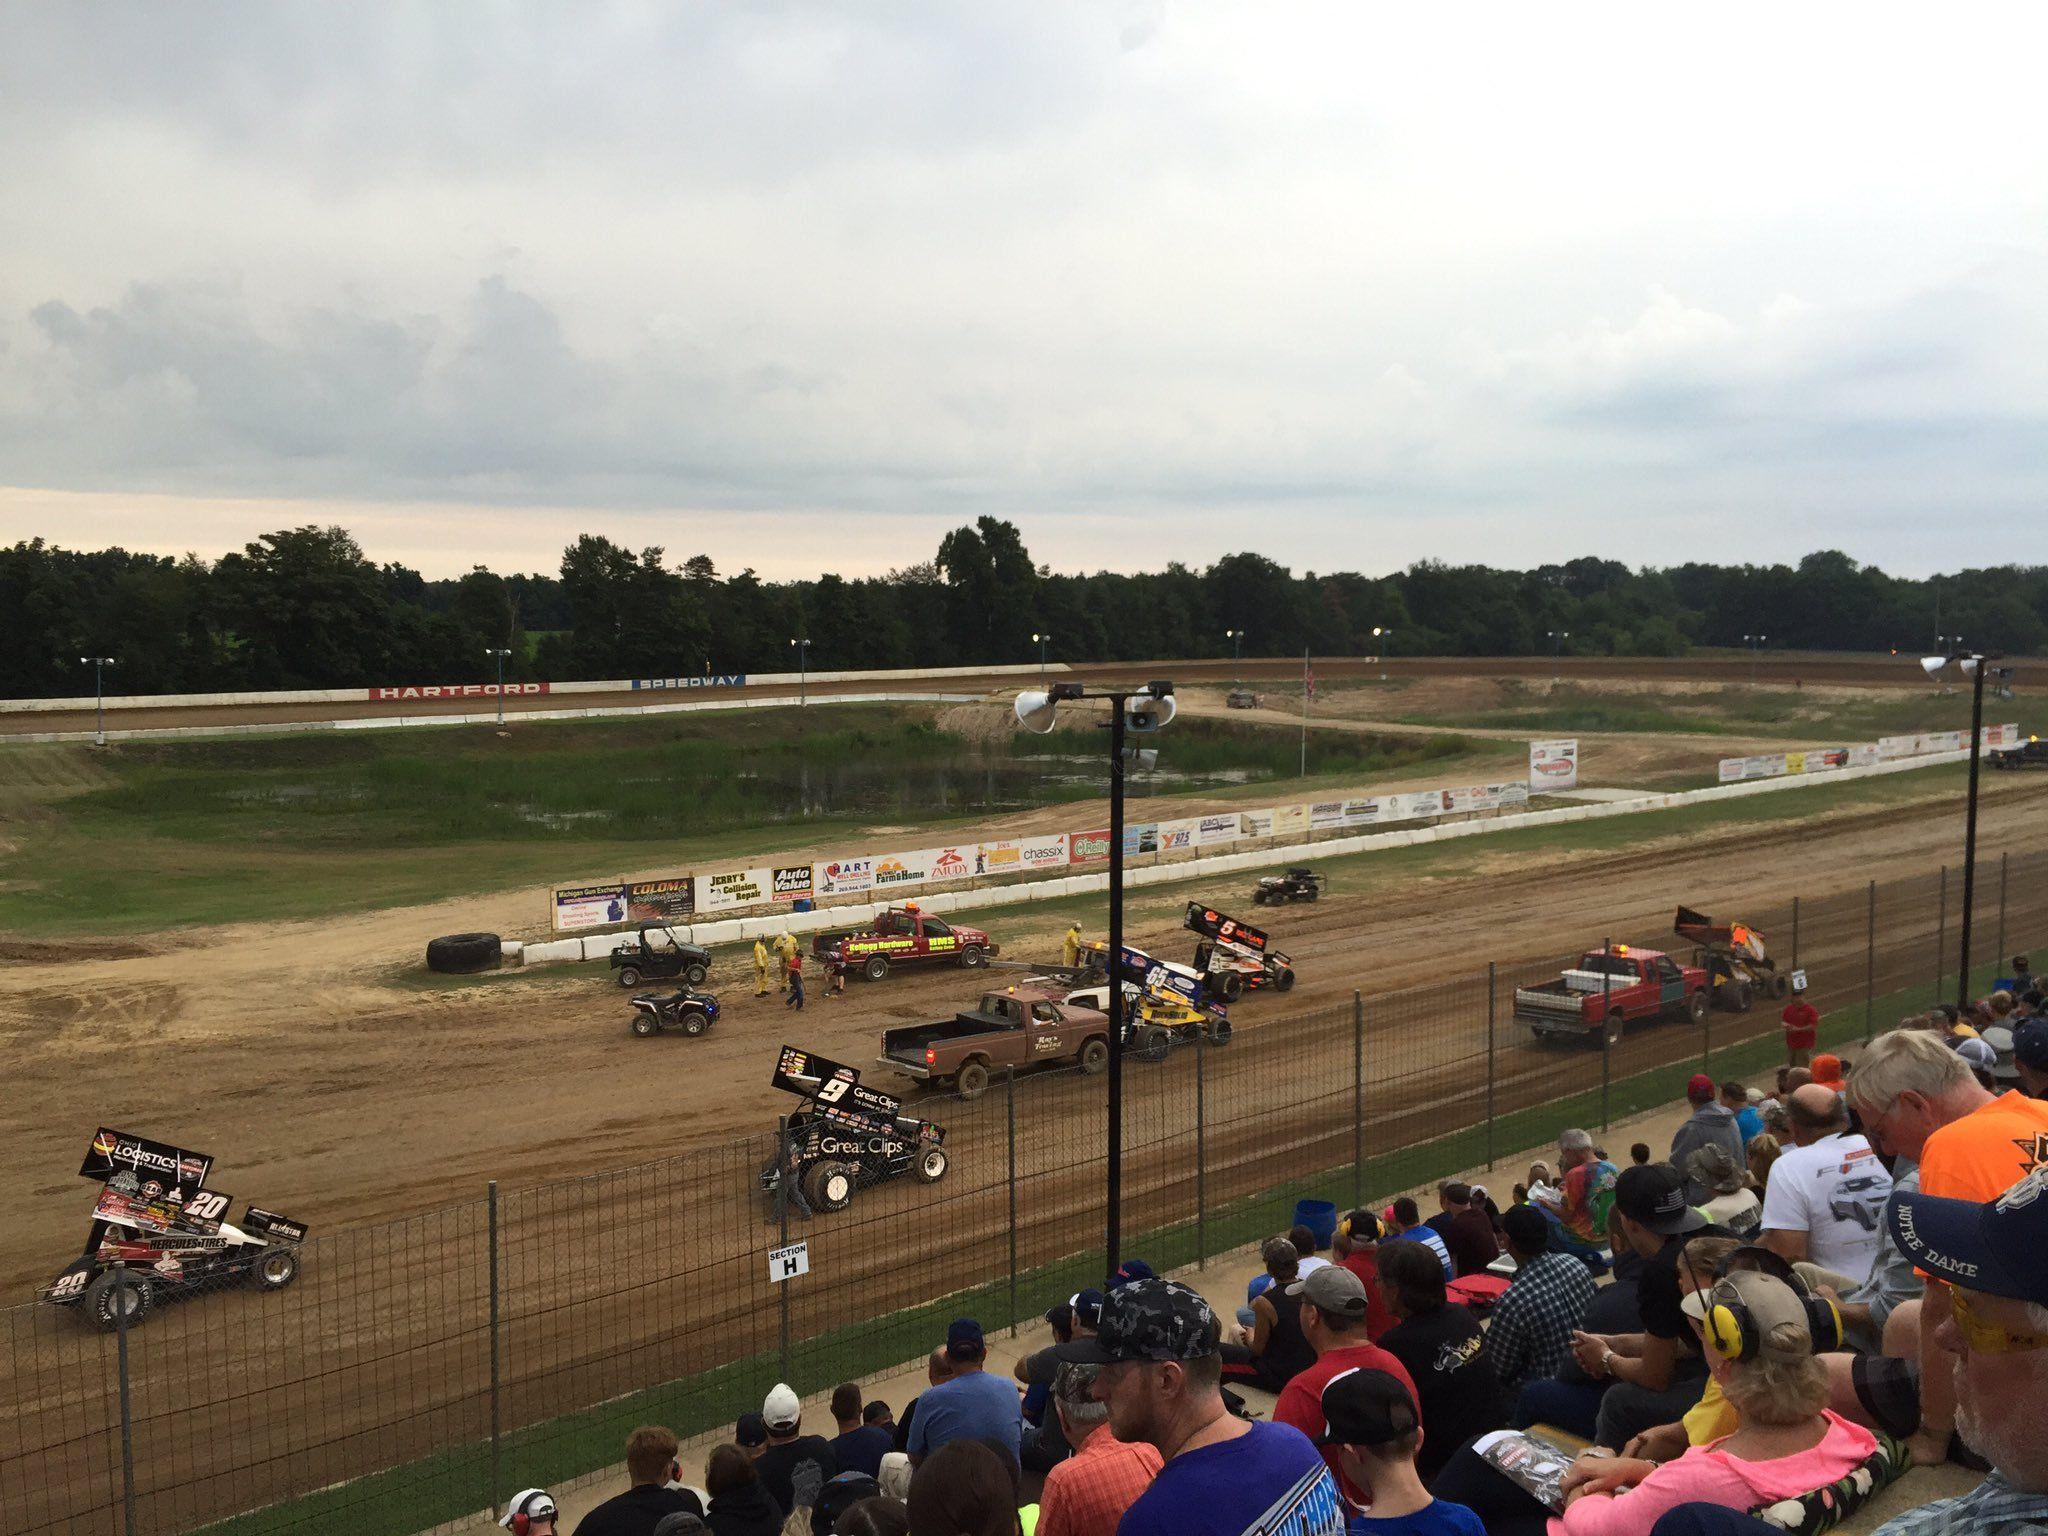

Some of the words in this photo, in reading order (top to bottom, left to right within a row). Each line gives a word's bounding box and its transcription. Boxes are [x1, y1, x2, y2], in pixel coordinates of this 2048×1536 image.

[639, 675, 738, 690] SPEEDWAY
[379, 682, 541, 700] HARTFORD
[1023, 847, 1064, 860] chassix
[709, 873, 746, 887] JERRY'S
[777, 868, 810, 881] Auto
[558, 889, 584, 898] Michigan
[584, 887, 597, 896] Gun
[596, 885, 624, 895] Exchange
[632, 880, 688, 895] COLOMA
[723, 883, 757, 894] Collision
[774, 878, 812, 892] Value
[736, 890, 761, 901] Repair
[1220, 920, 1237, 935] 5
[849, 942, 878, 952] Kellogg
[878, 940, 914, 949] Hardware
[1146, 966, 1169, 987] 65
[817, 1078, 850, 1103] 9
[853, 1087, 879, 1103] Great
[878, 1095, 899, 1110] Clips
[118, 1139, 138, 1149] OHIO
[820, 1137, 866, 1154] Great
[868, 1137, 903, 1158] Clips
[113, 1145, 178, 1169] LOGISTICS
[184, 1192, 229, 1219] 20
[149, 1237, 199, 1250] HERCULES
[199, 1236, 229, 1249] TIRES
[1897, 1203, 1925, 1251] NOTRE
[1924, 1249, 1979, 1278] DAME
[769, 1244, 806, 1261] SECTION
[783, 1256, 798, 1276] H
[51, 1271, 88, 1297] 20
